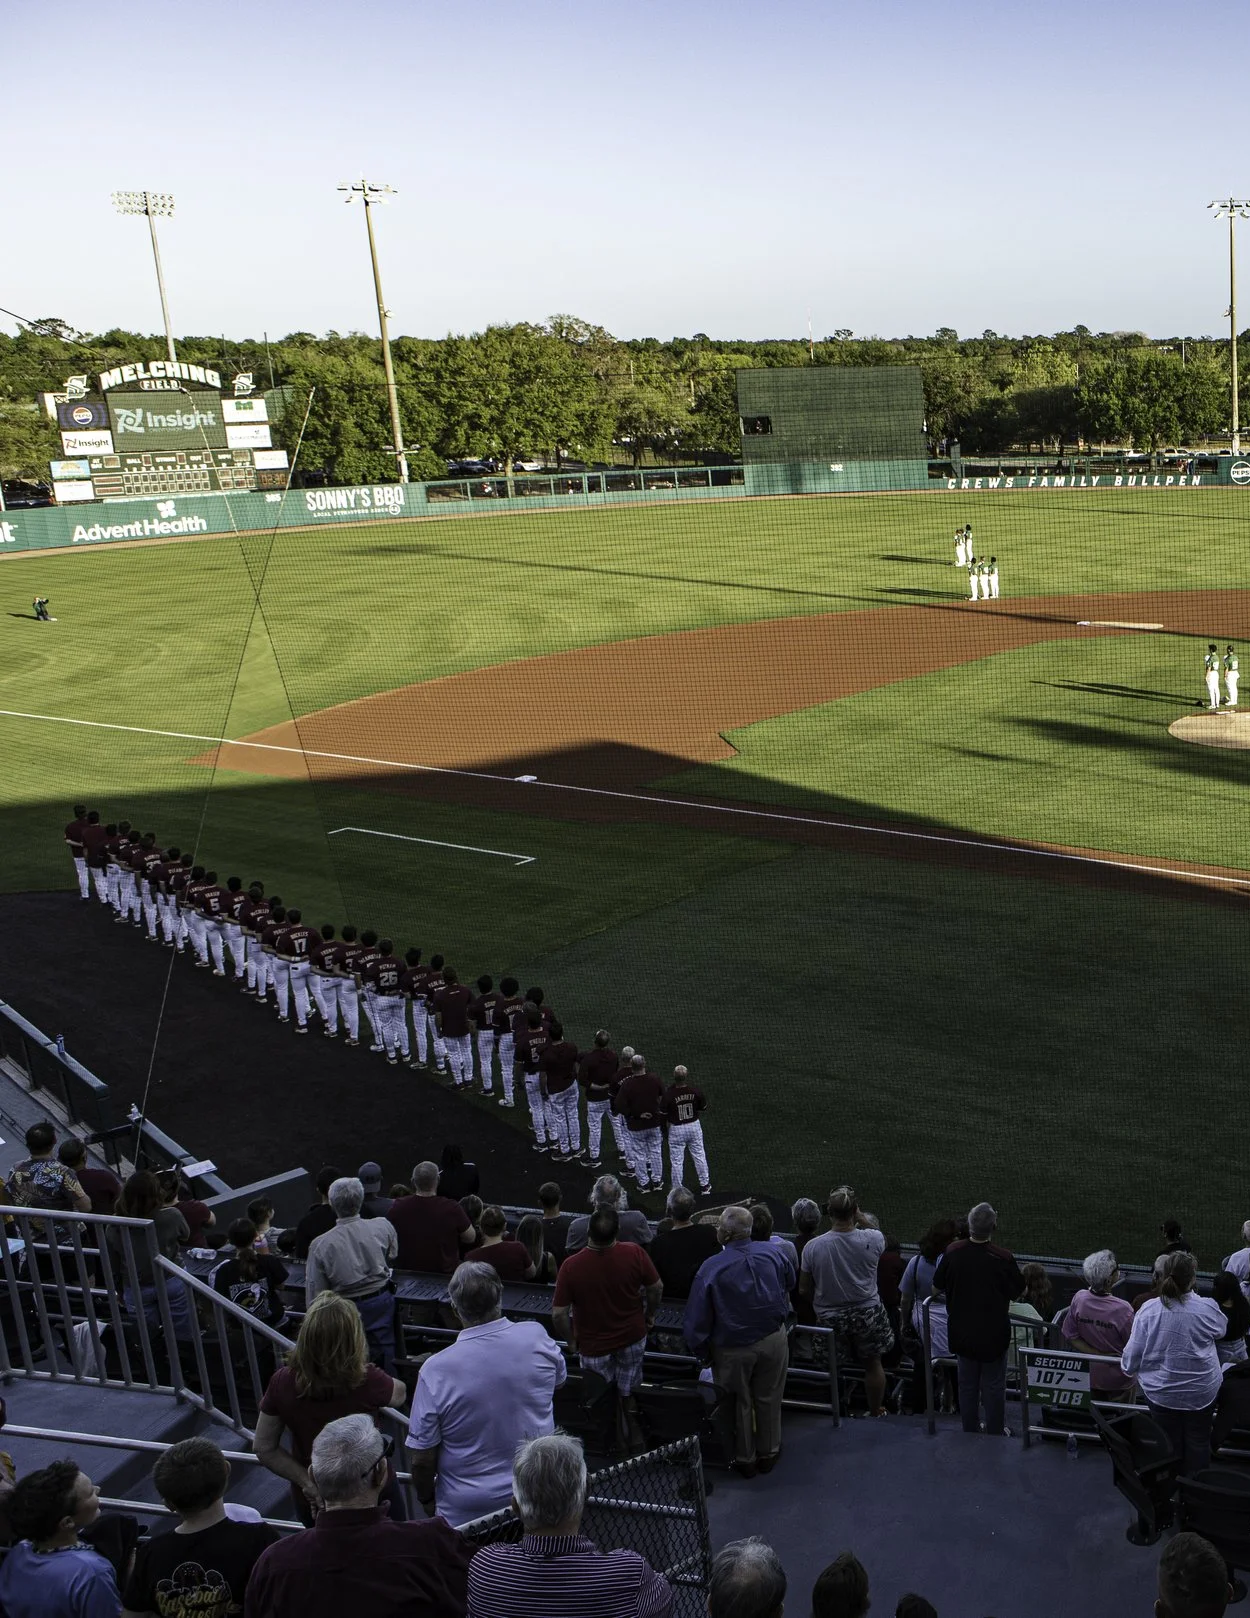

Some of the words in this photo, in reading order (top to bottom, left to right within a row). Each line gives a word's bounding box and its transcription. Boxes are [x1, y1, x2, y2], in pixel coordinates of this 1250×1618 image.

[100, 361, 222, 390] MELCHING
[143, 380, 178, 389] FIELD
[146, 410, 217, 430] Insight
[78, 439, 109, 448] Insight
[947, 477, 1014, 489] CREWS
[1028, 475, 1100, 488] FAMILY
[1115, 475, 1201, 487] BULLPEN
[305, 488, 372, 511] SONNY'S
[373, 486, 405, 506] BBQ
[73, 516, 208, 542] AdventHealth
[379, 971, 398, 987] 26
[677, 1103, 694, 1121] 10
[1034, 1357, 1082, 1371] SECTION
[1035, 1370, 1066, 1385] 107
[1052, 1390, 1084, 1406] 108
